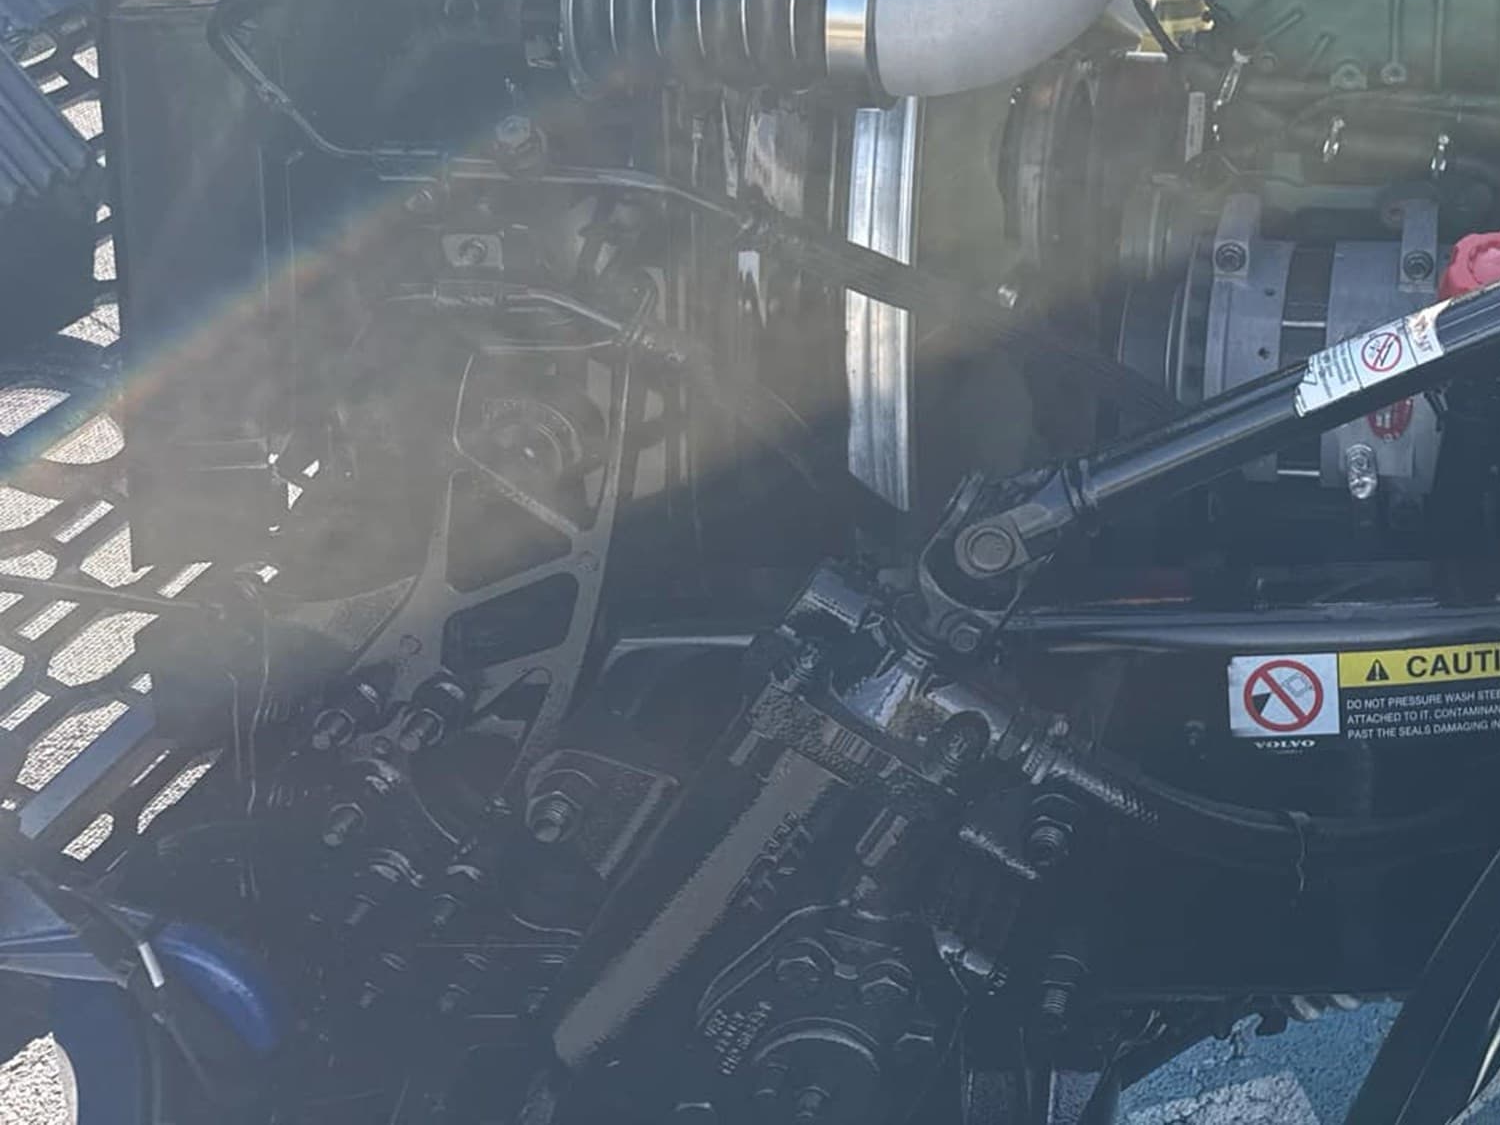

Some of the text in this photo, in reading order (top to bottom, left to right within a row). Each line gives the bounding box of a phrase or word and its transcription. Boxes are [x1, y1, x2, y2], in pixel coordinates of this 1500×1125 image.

[1346, 698, 1362, 710] DO
[1364, 697, 1385, 709] NOT
[1388, 693, 1442, 708] PRESSURE
[1444, 691, 1476, 704] WASH
[1347, 712, 1401, 725] ATTACHED
[1404, 710, 1418, 721] TO
[1347, 727, 1374, 740] PAST
[1375, 726, 1398, 738] THE
[1398, 723, 1431, 736] SEALS
[1433, 719, 1488, 735] DAMAGING
[1253, 739, 1316, 750] VOLVO
